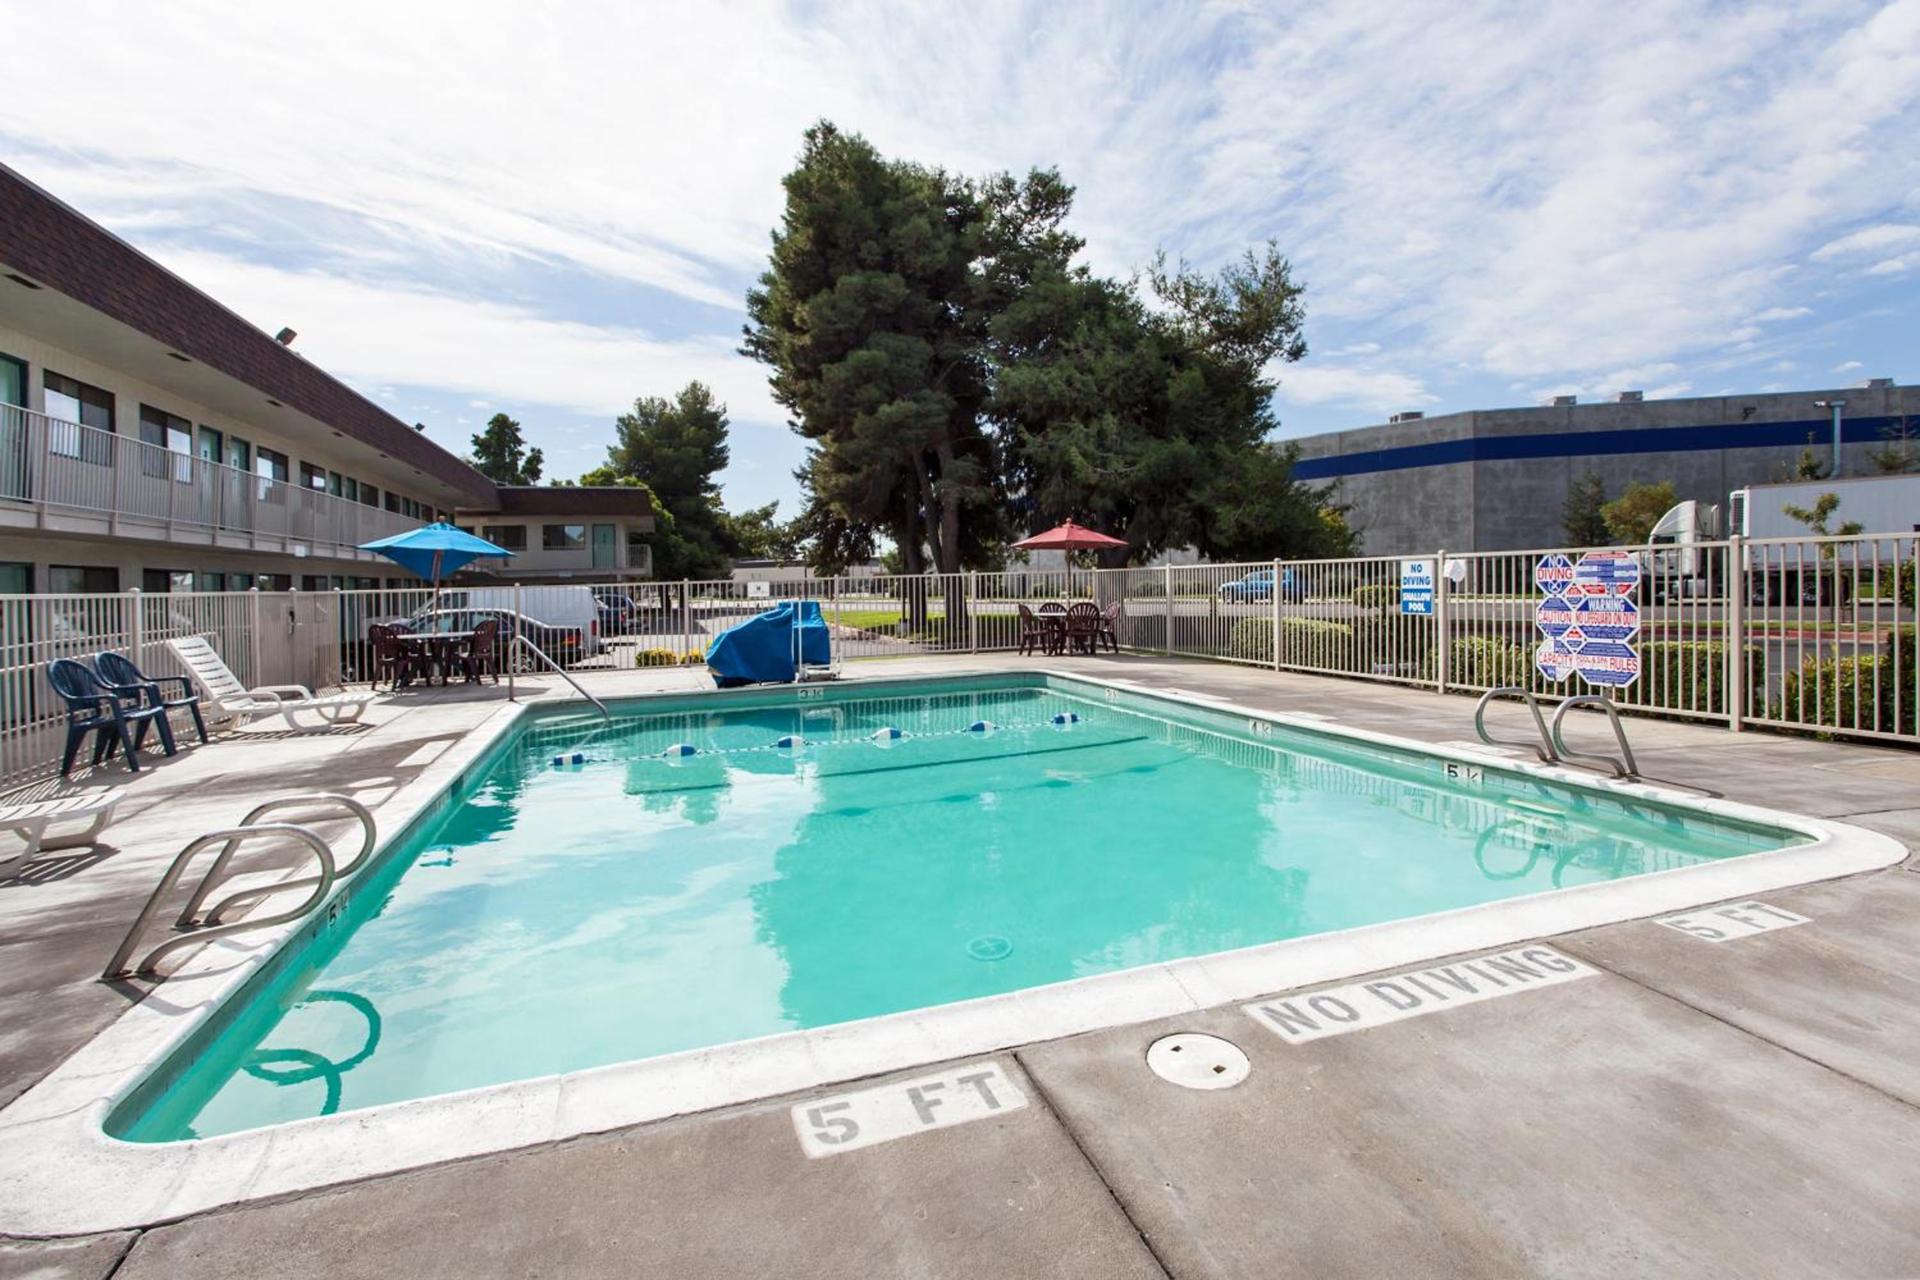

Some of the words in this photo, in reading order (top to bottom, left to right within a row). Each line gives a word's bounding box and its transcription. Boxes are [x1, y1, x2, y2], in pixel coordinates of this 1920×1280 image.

[1411, 563, 1423, 573] NO
[1547, 555, 1564, 567] NO
[1402, 575, 1431, 586] DIVING
[1537, 567, 1573, 580] DIVING
[1402, 591, 1431, 601] SHALLOW
[1408, 602, 1426, 612] POOL
[1588, 598, 1626, 612] WARNING
[1537, 610, 1571, 624] CAUTION
[1538, 651, 1573, 669] CAPACITY
[1610, 657, 1638, 672] RULES
[1447, 763, 1458, 778] 5
[1665, 918, 1726, 939] 5
[1714, 902, 1799, 919] FT
[1260, 995, 1361, 1036] NO
[1362, 949, 1577, 1011] DIVING
[806, 1101, 860, 1145] 5
[906, 1070, 1002, 1125] FT
